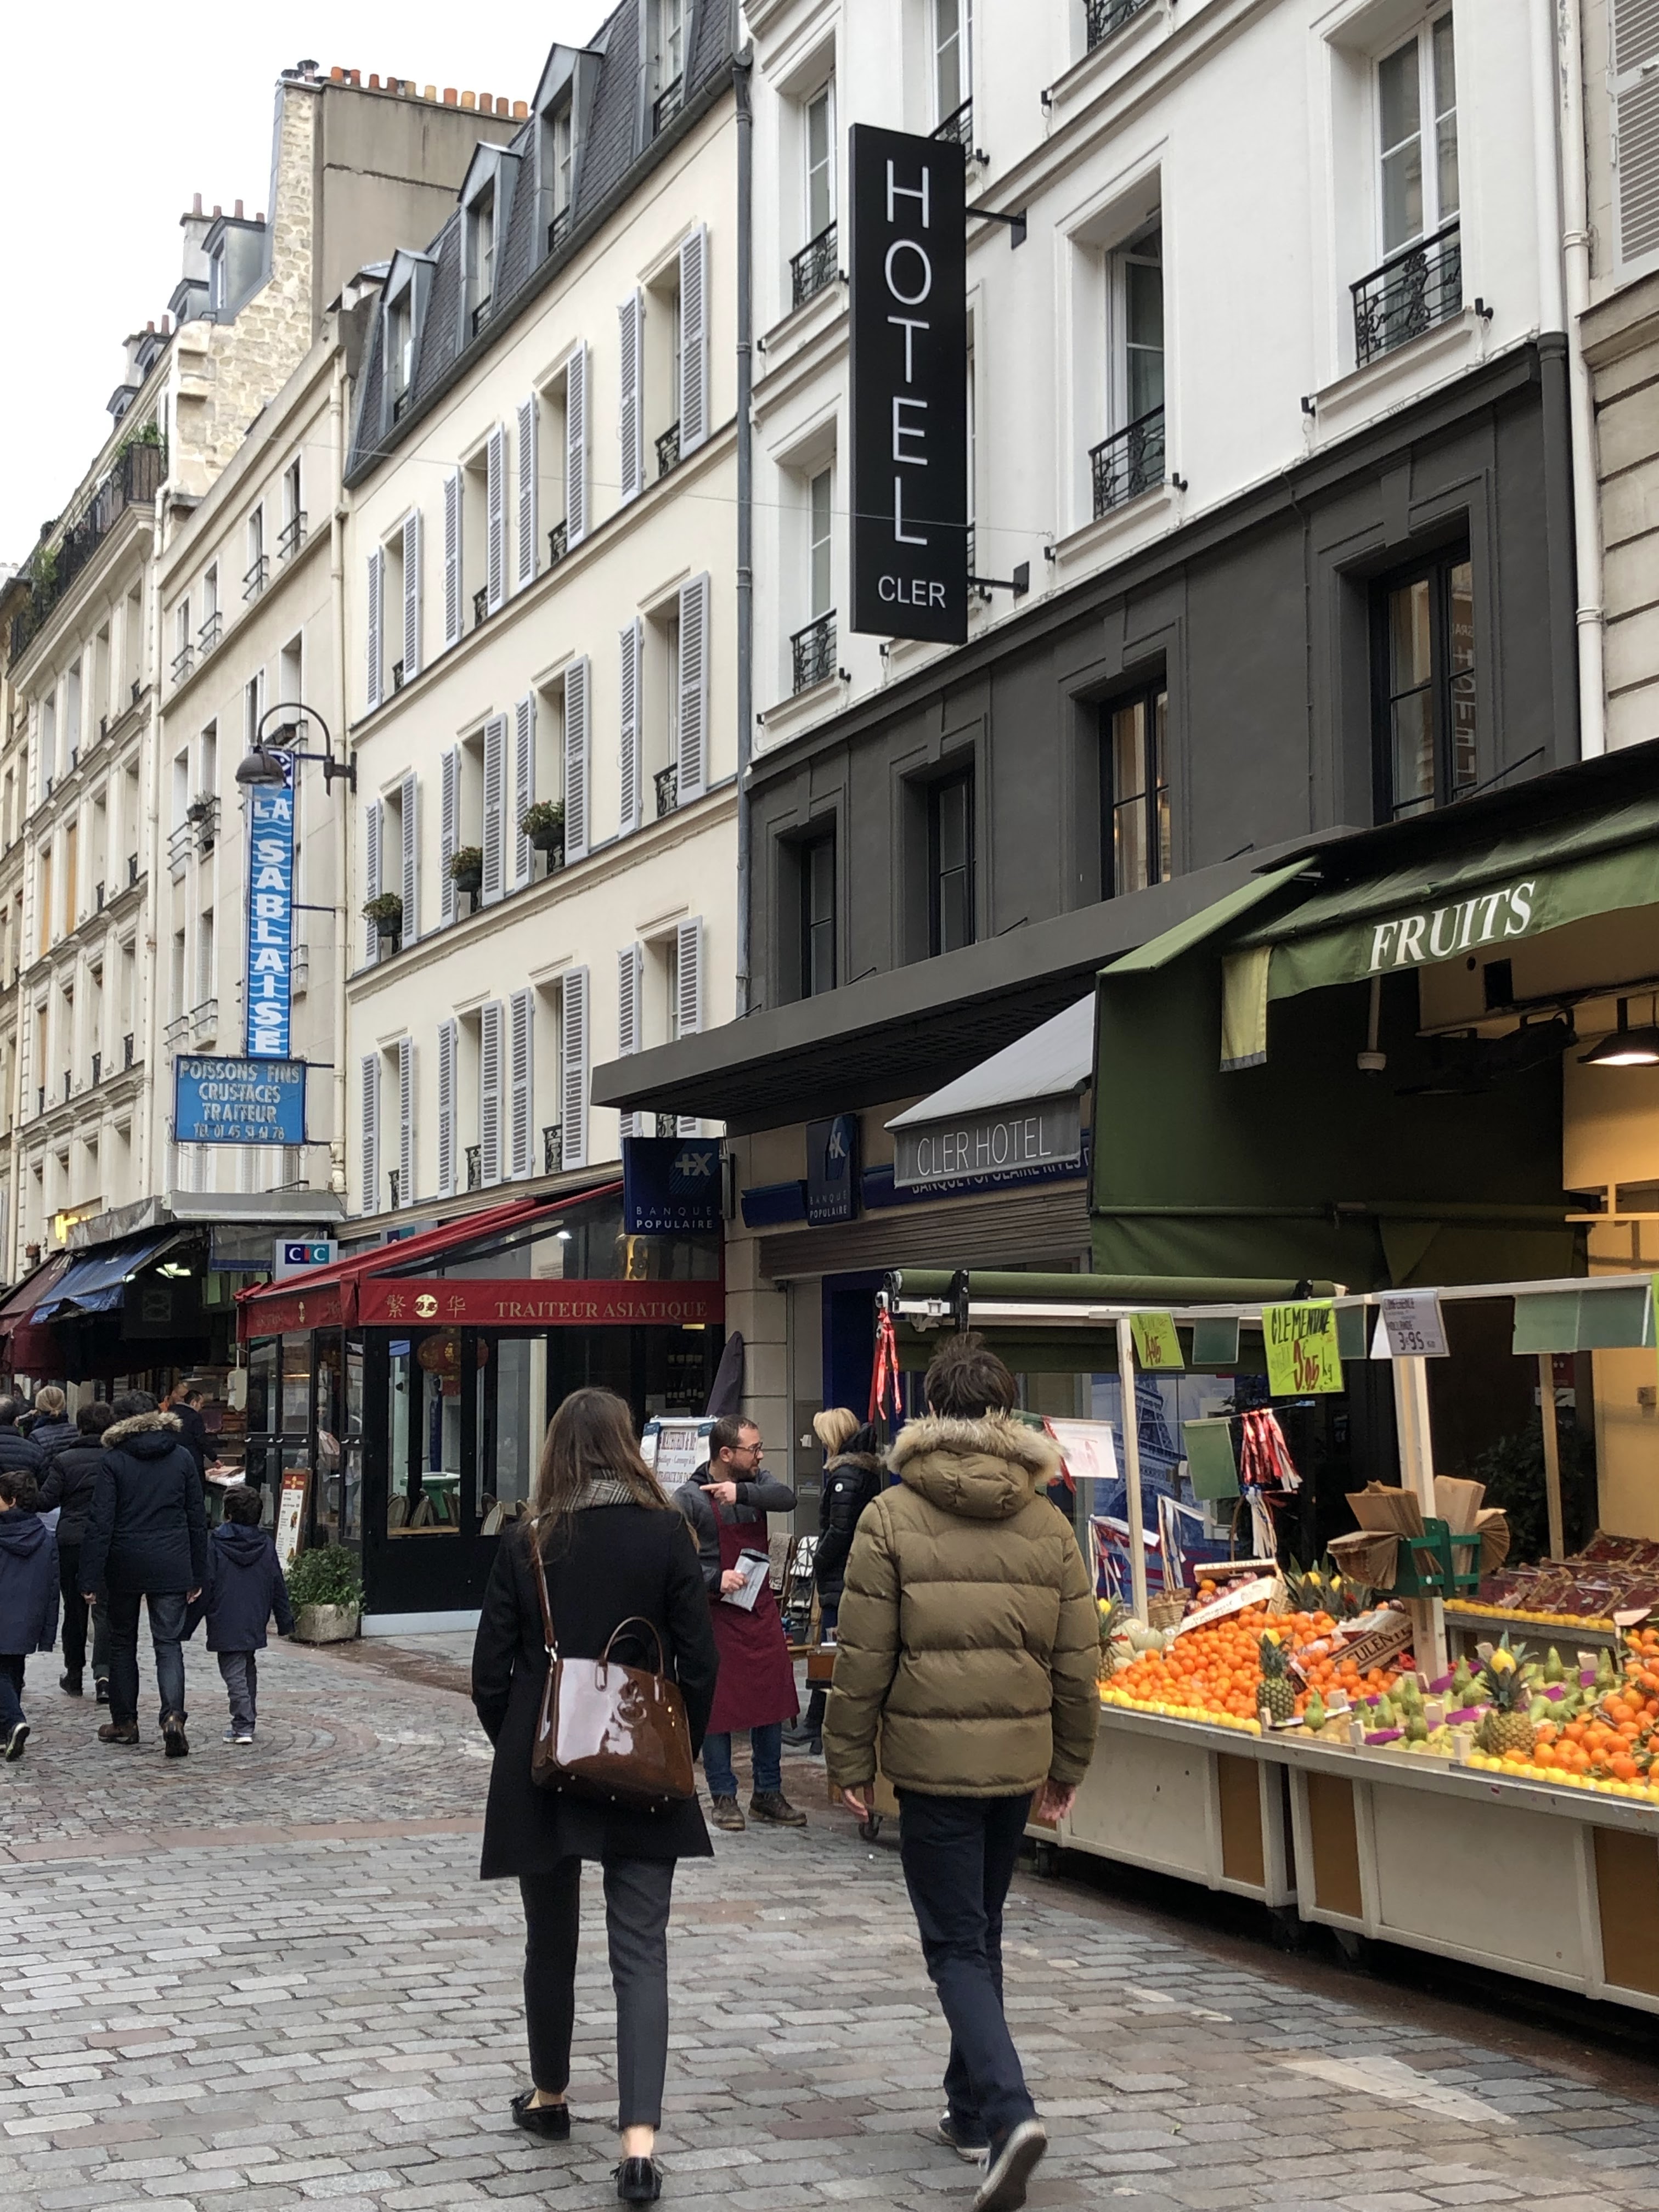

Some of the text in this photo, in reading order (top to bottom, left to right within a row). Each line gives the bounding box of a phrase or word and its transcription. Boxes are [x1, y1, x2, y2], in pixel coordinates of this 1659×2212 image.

[884, 159, 932, 546] HOTEL
[878, 575, 946, 609] CLER
[254, 798, 290, 820] LA
[1367, 881, 1536, 972] FRUITS
[253, 838, 286, 1054] SABLAISE
[179, 1060, 300, 1084] POISSONS FINS
[198, 1082, 281, 1104] CRUSTACES
[201, 1103, 277, 1124] TRAITEUR
[917, 1116, 1052, 1176] CLER HOTEL
[809, 1189, 847, 1205] BANQUE
[636, 1206, 712, 1216] BANQUE
[809, 1204, 848, 1219] POPULAIRE
[636, 1219, 713, 1229] POPULAIRE
[289, 1247, 326, 1261] CIC
[446, 1295, 466, 1318] 华
[494, 1301, 708, 1319] TRAITEUR ASIATIQUE
